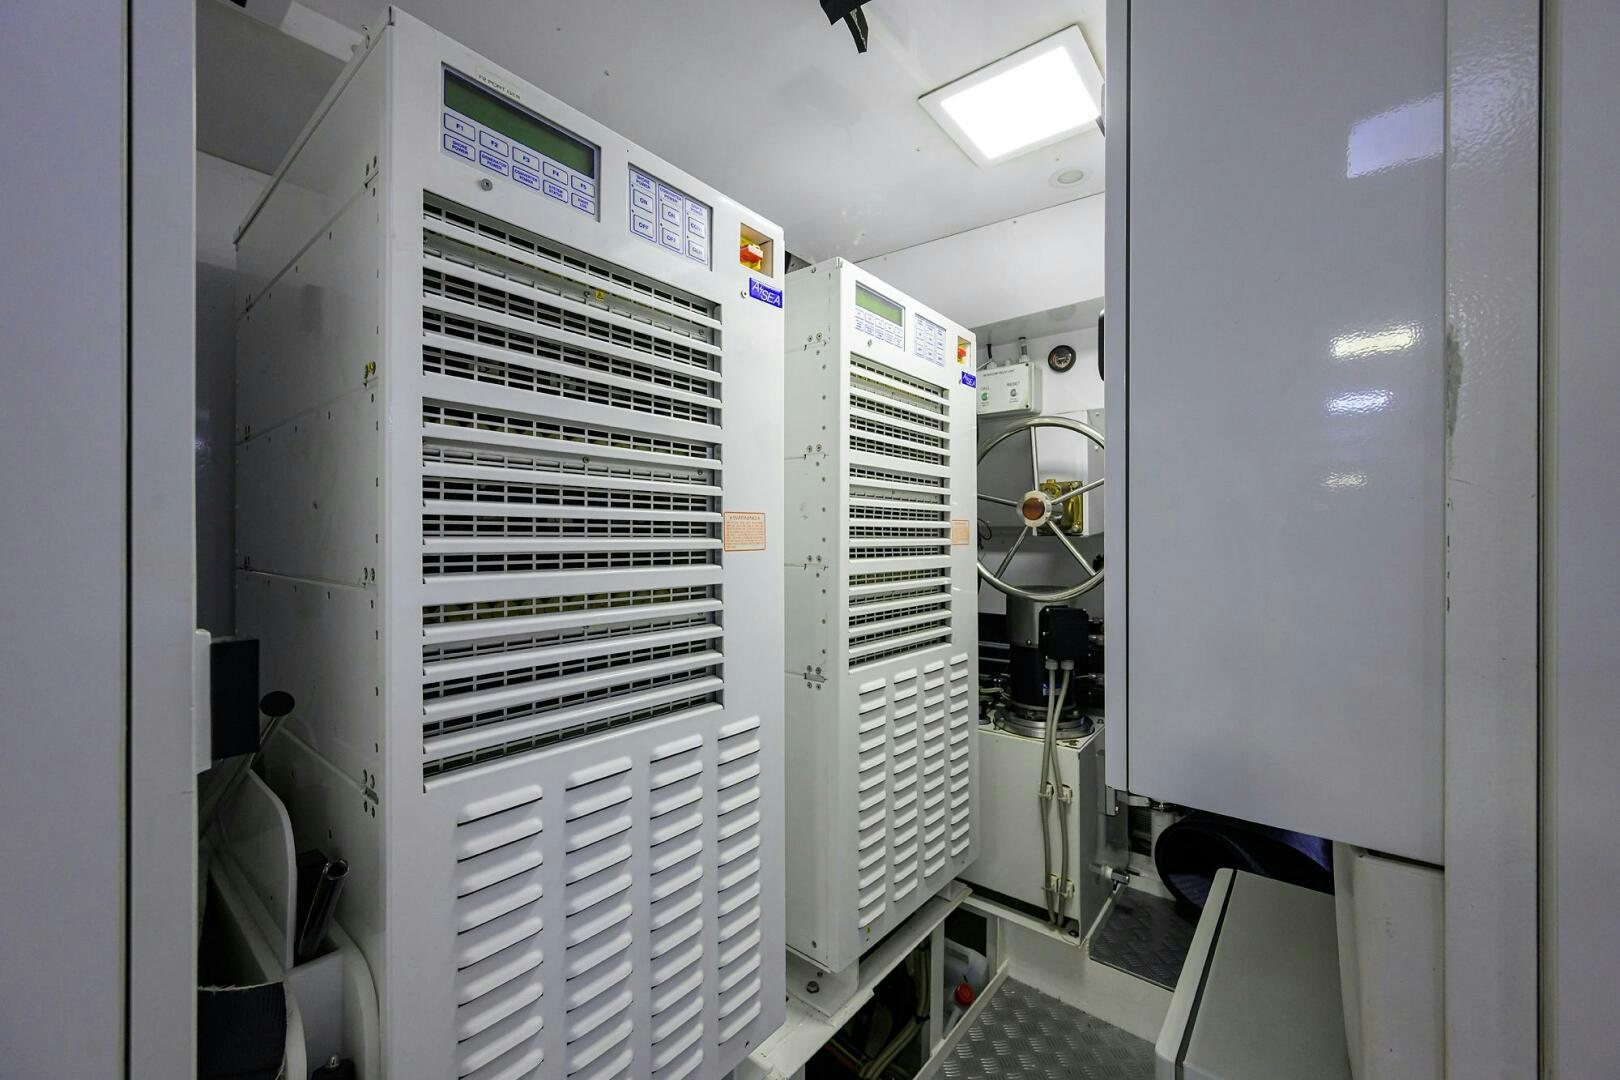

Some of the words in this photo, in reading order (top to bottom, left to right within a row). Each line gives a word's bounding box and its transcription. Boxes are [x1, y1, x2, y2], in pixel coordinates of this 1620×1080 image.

[456, 123, 464, 131] F1
[453, 140, 468, 150] SHORE
[490, 140, 498, 148] F2
[452, 144, 468, 155] POWER
[482, 154, 506, 168] GENERATOR
[486, 160, 502, 171] POWER
[520, 175, 534, 185] POWER
[636, 180, 650, 190] POWER
[640, 197, 648, 206] ON
[664, 194, 678, 204] POWER
[667, 211, 676, 219] ON
[638, 222, 649, 230] OFF
[666, 234, 676, 243] OFF
